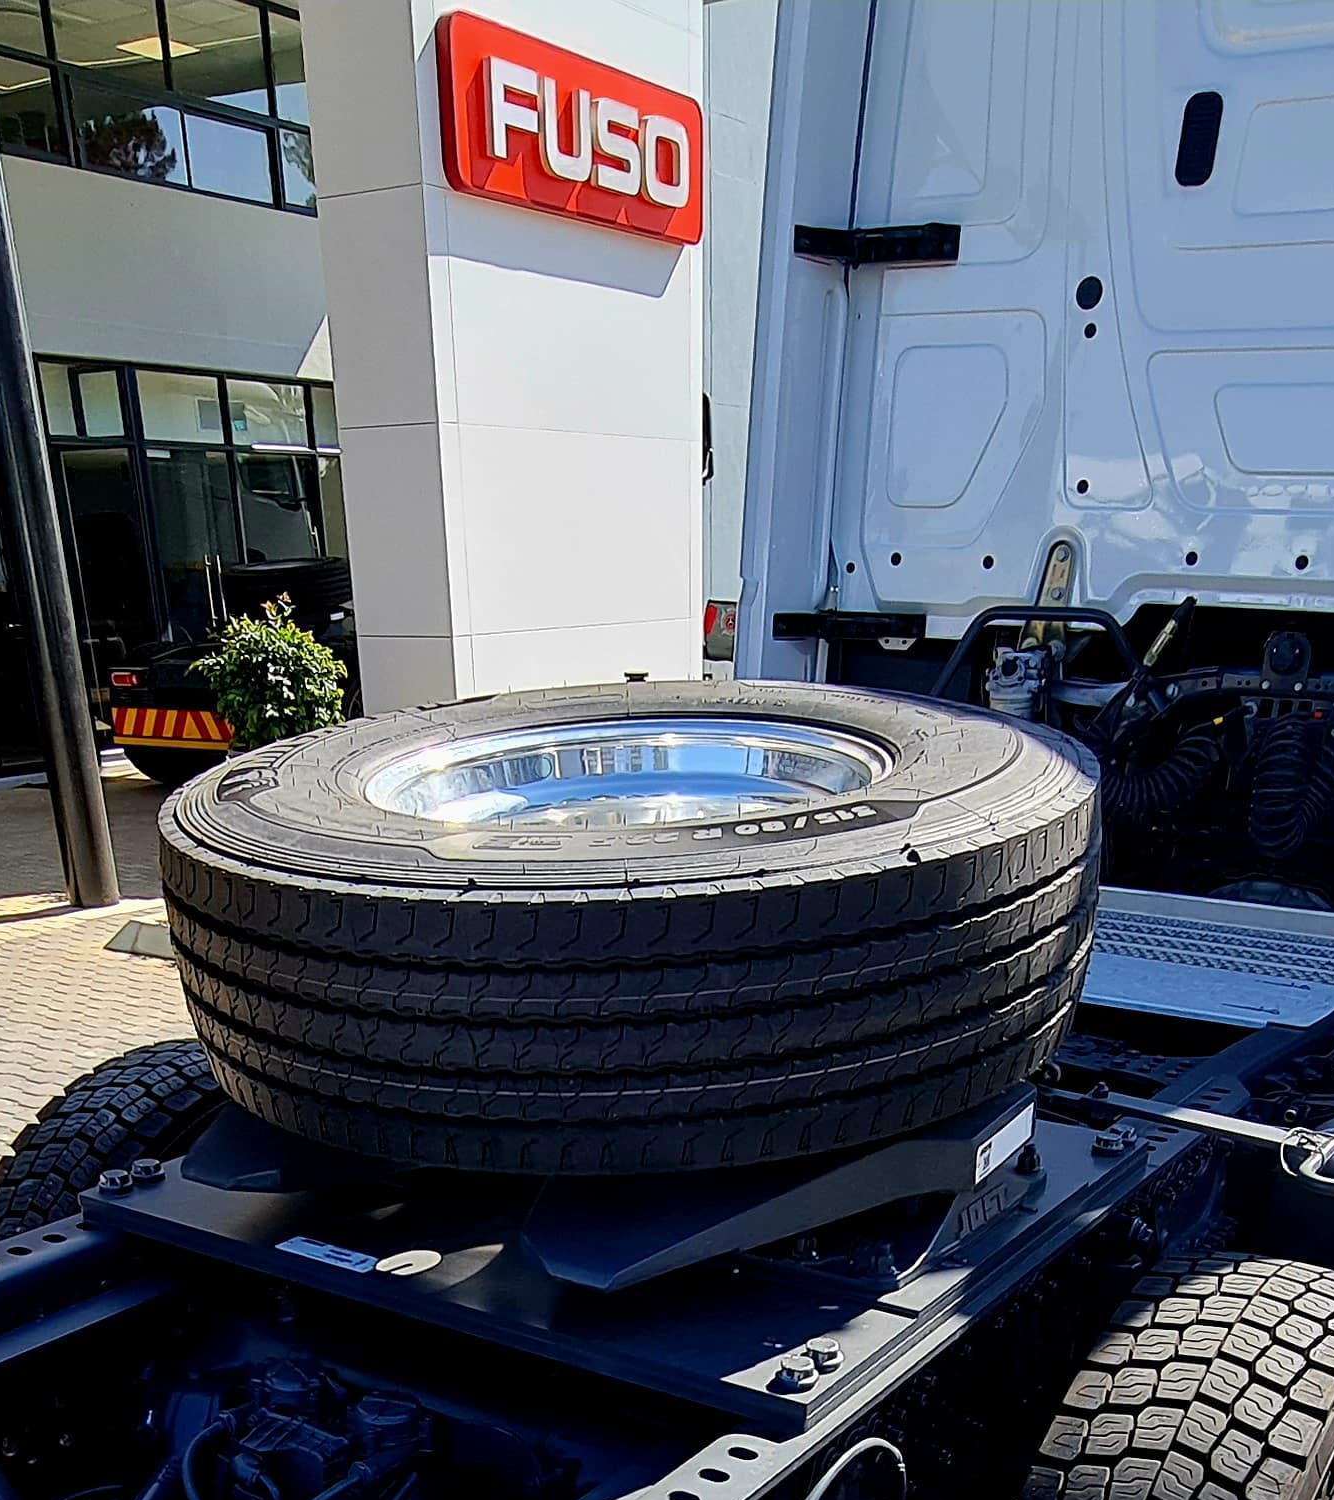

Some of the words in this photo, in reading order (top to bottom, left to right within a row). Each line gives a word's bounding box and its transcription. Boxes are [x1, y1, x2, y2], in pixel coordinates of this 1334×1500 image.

[484, 55, 691, 209] FUSO
[692, 827, 723, 841] R
[733, 805, 878, 836] 315/80
[958, 1183, 1008, 1239] JOST
